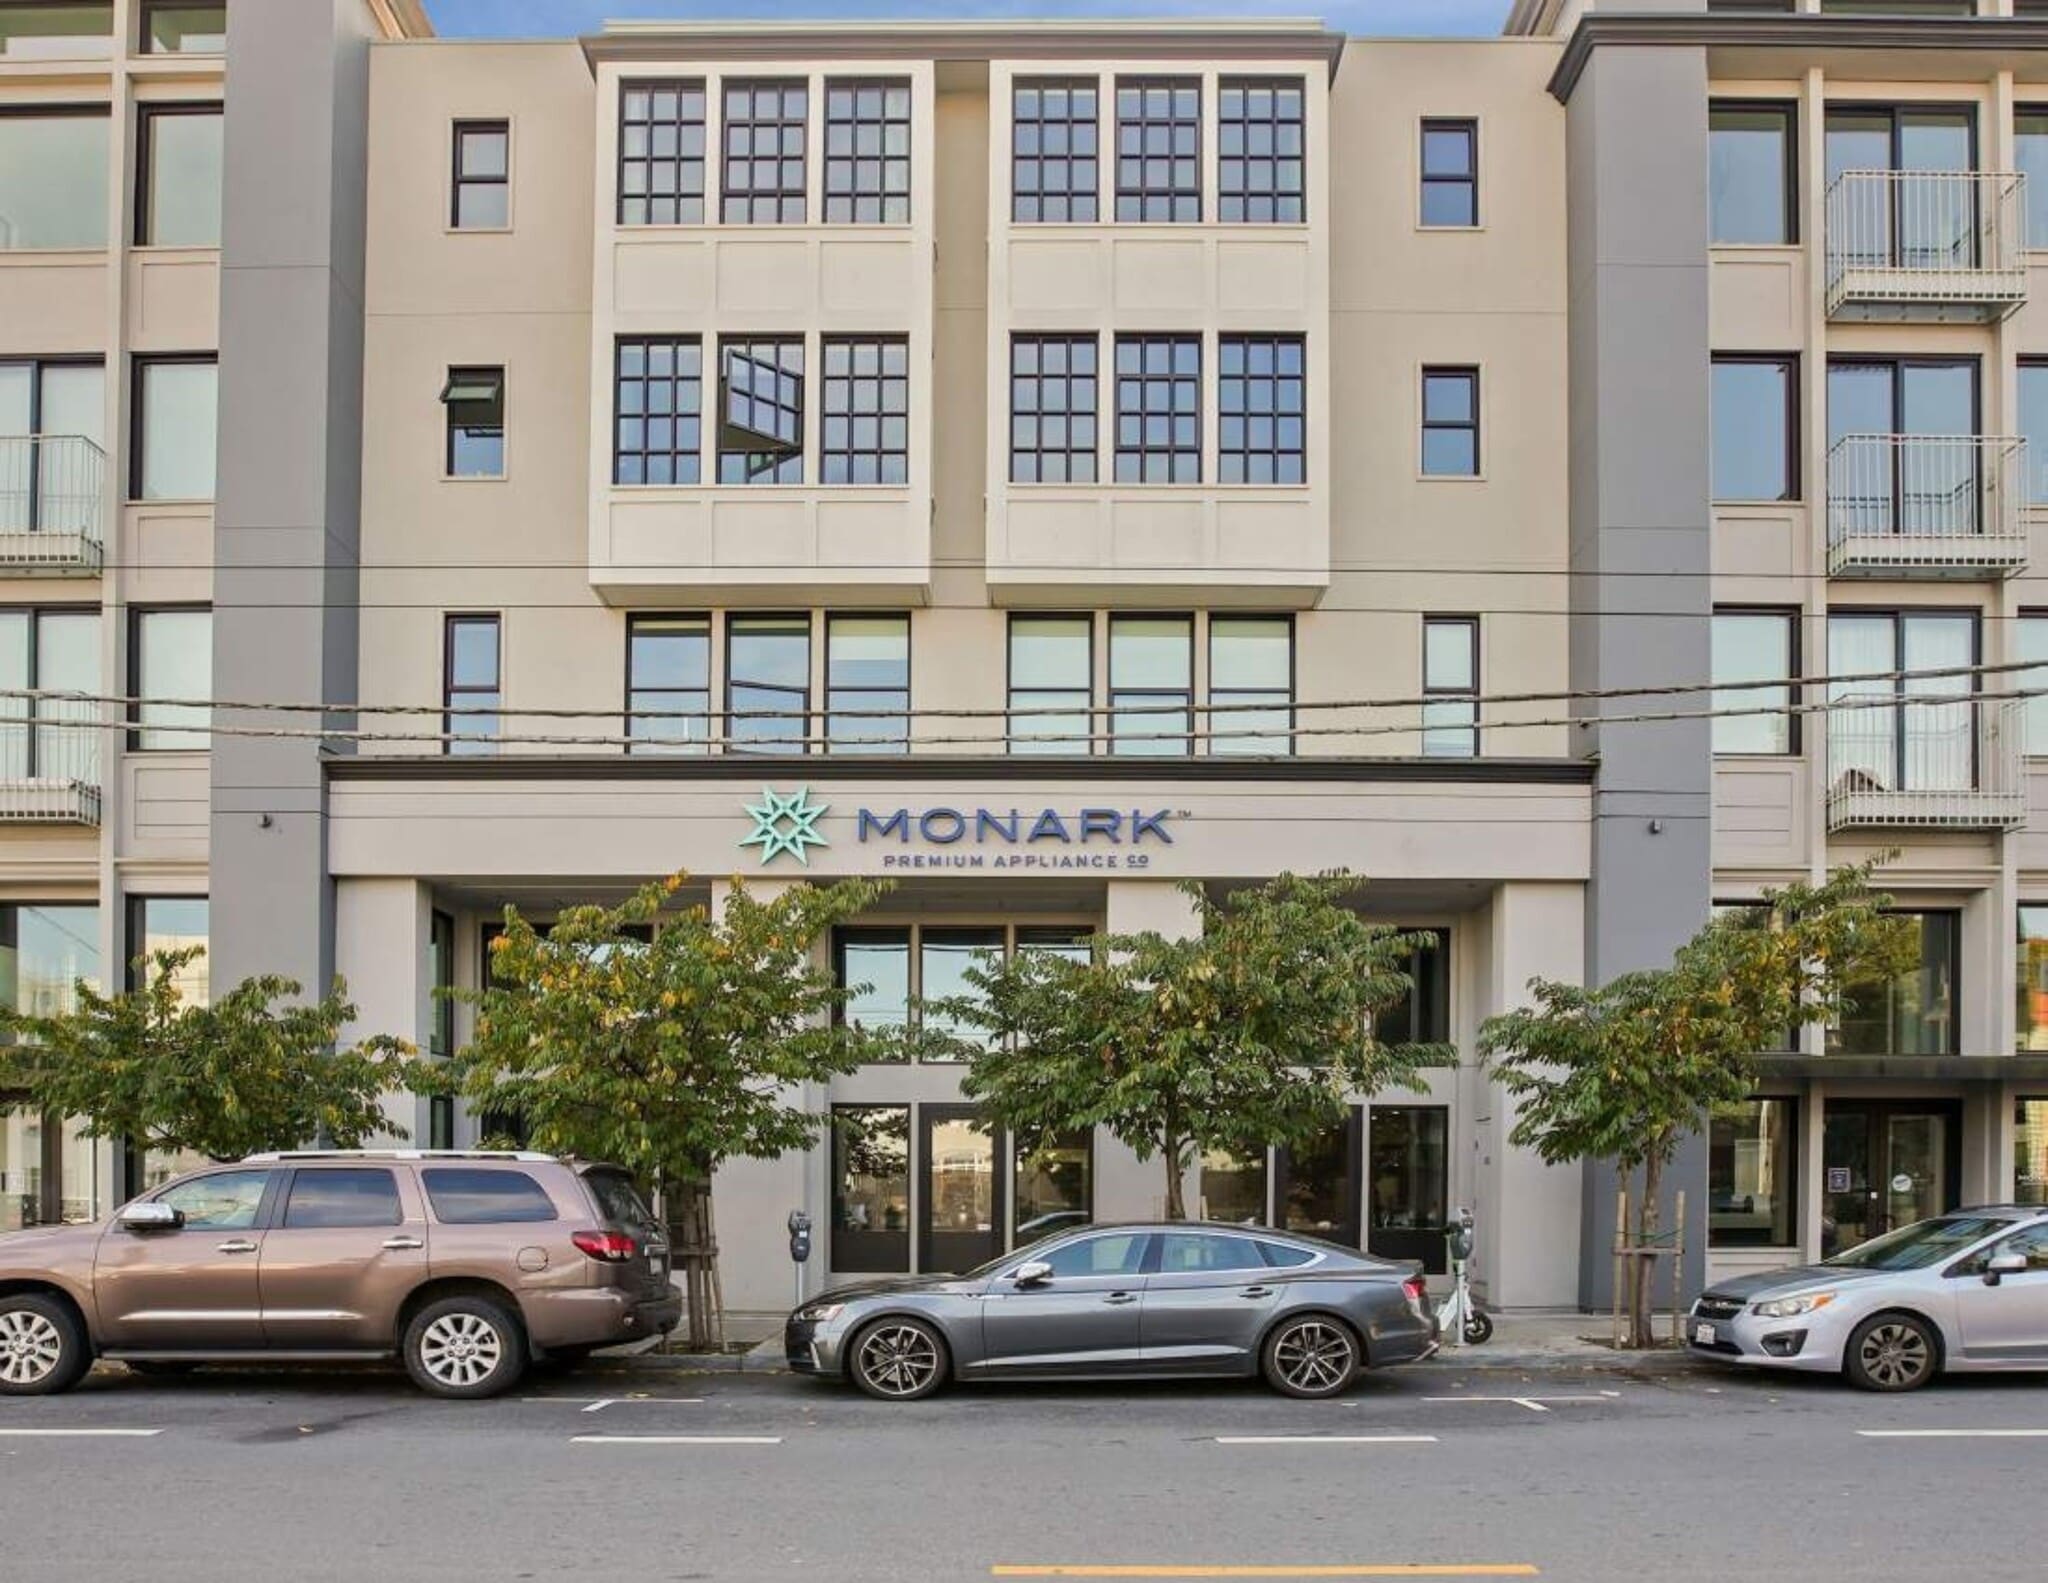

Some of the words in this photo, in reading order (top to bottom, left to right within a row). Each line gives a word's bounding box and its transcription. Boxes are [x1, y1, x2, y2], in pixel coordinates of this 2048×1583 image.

[858, 808, 1173, 844] MONARK
[883, 855, 984, 868] PREMIUM
[993, 855, 1118, 869] APPLIANCE
[1127, 854, 1149, 868] CO
